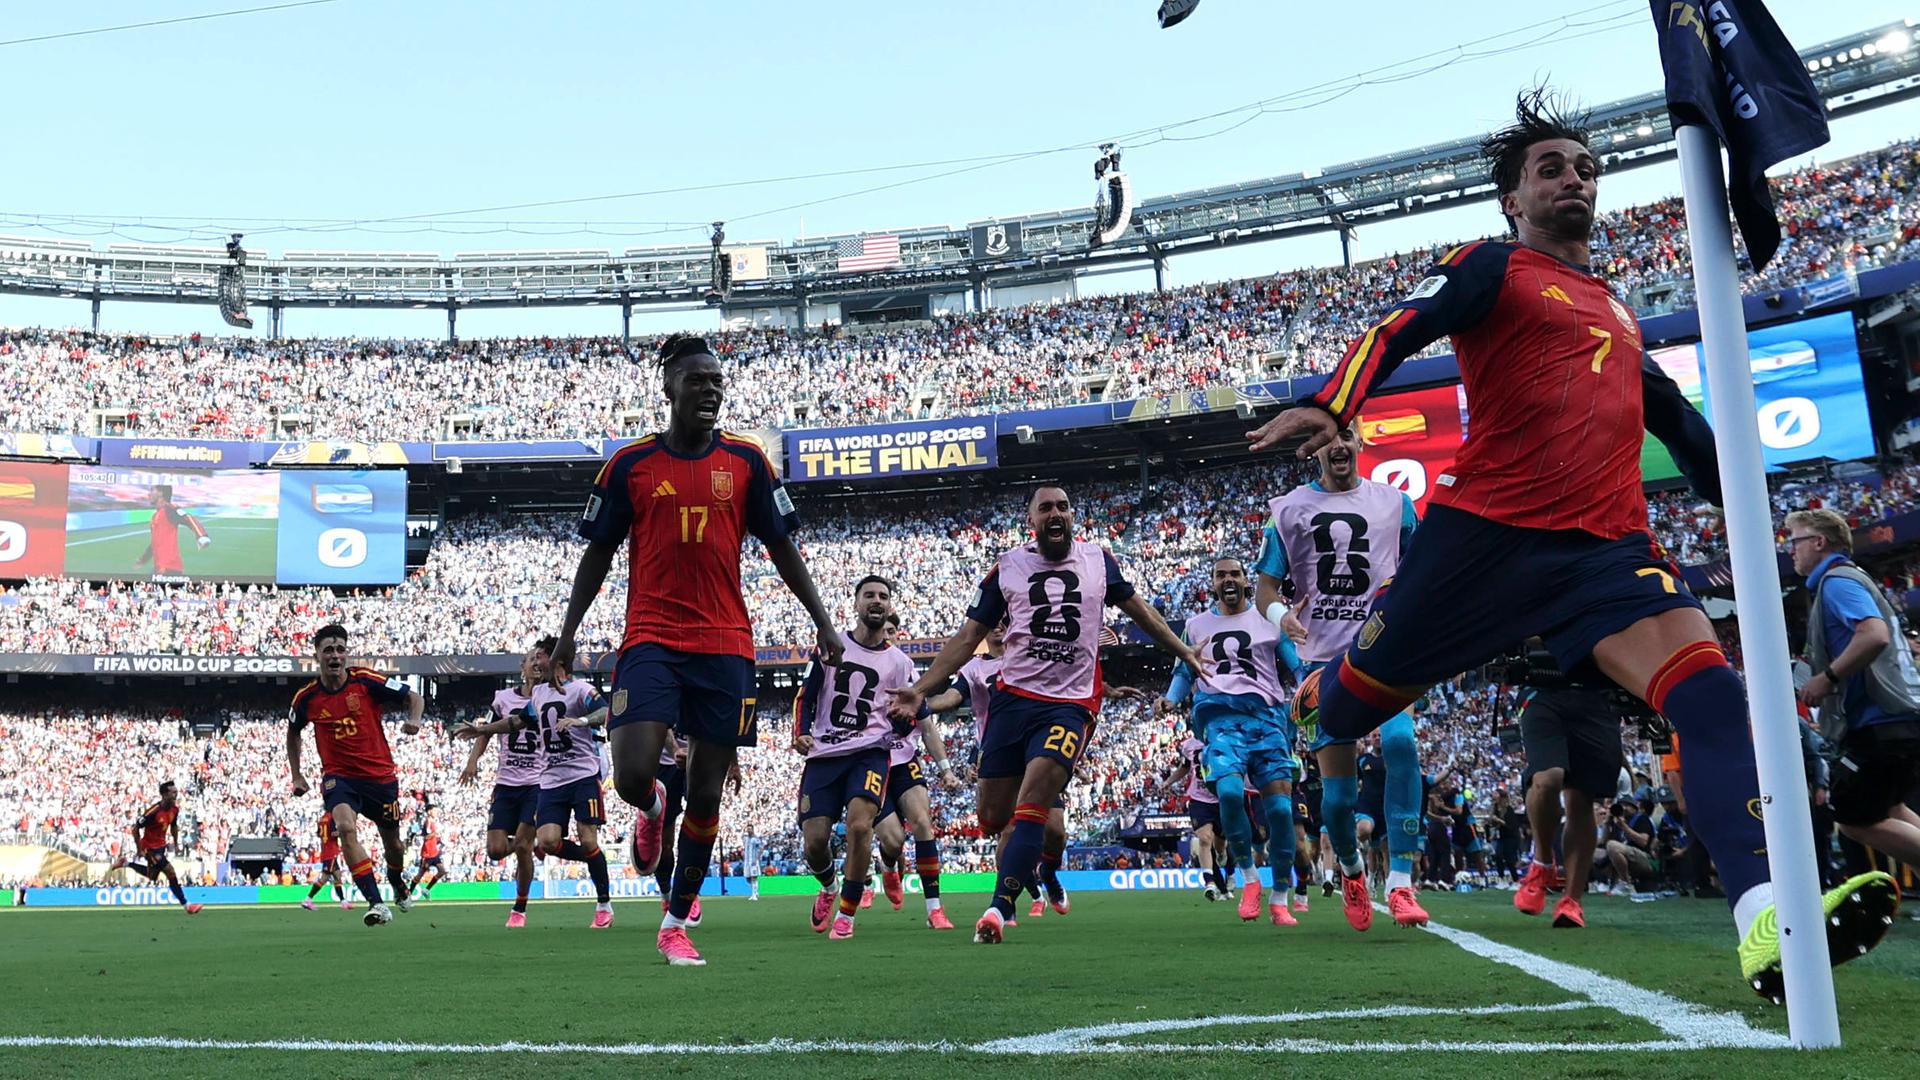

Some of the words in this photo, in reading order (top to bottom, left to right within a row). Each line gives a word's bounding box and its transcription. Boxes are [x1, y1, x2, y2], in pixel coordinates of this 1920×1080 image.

[1589, 326, 1612, 374] 7
[799, 438, 832, 453] FIFA
[833, 434, 893, 450] WORLD
[895, 431, 928, 447] CUP
[929, 426, 987, 443] 2026
[130, 445, 222, 463] #FIFAWorldCup
[800, 450, 872, 478] THE
[879, 441, 988, 473] FINAL
[679, 505, 709, 543] 17
[318, 527, 368, 568] 0
[152, 575, 190, 583] Hisense
[1329, 577, 1355, 589] FIFA
[1634, 567, 1679, 594] 7
[1349, 600, 1368, 608] CUP
[1311, 607, 1367, 621] 2026
[1043, 625, 1068, 635] FIFA
[756, 649, 791, 660] NEW
[898, 641, 944, 654] ERSE
[1026, 648, 1075, 664] 2026
[93, 657, 130, 671] FIFA
[133, 658, 194, 672] WORLD
[197, 658, 231, 672] CUP
[233, 659, 293, 673] 2026
[298, 658, 318, 672] TH
[351, 658, 400, 672] INAL
[738, 697, 756, 737] 17
[838, 714, 857, 725] FIFA
[888, 741, 904, 750] 26
[1043, 725, 1079, 759] 26
[864, 770, 883, 797] 15
[588, 798, 599, 818] 11
